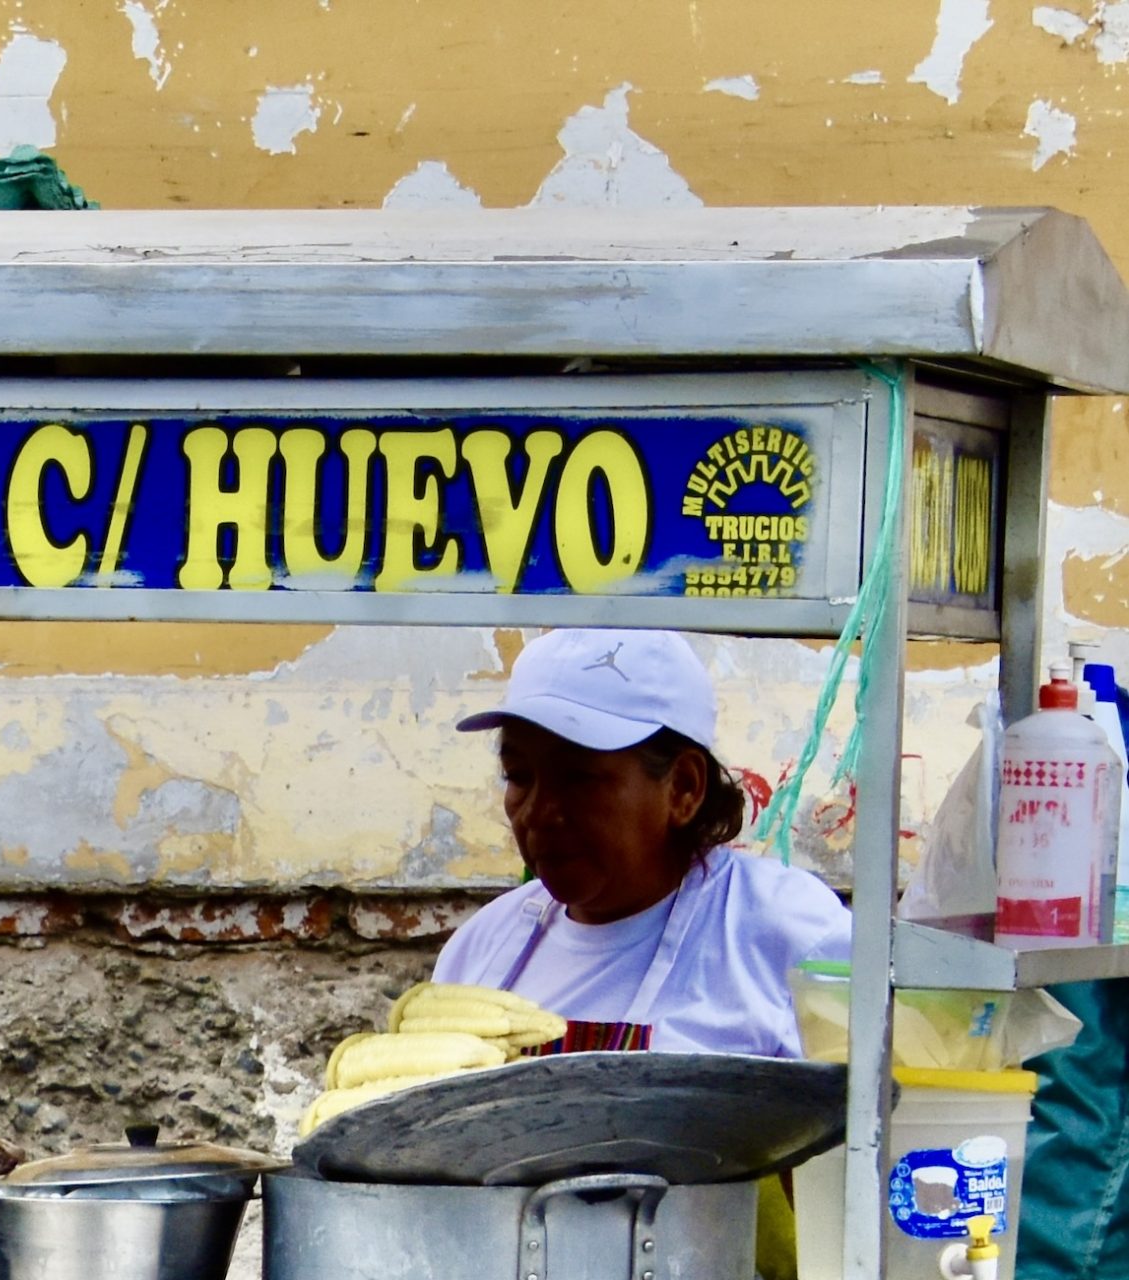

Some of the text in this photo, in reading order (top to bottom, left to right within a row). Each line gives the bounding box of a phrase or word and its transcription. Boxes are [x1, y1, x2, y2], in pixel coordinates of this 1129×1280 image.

[6, 424, 147, 589] C/
[178, 426, 649, 595] HUEVO
[705, 516, 810, 541] TRUCIOS
